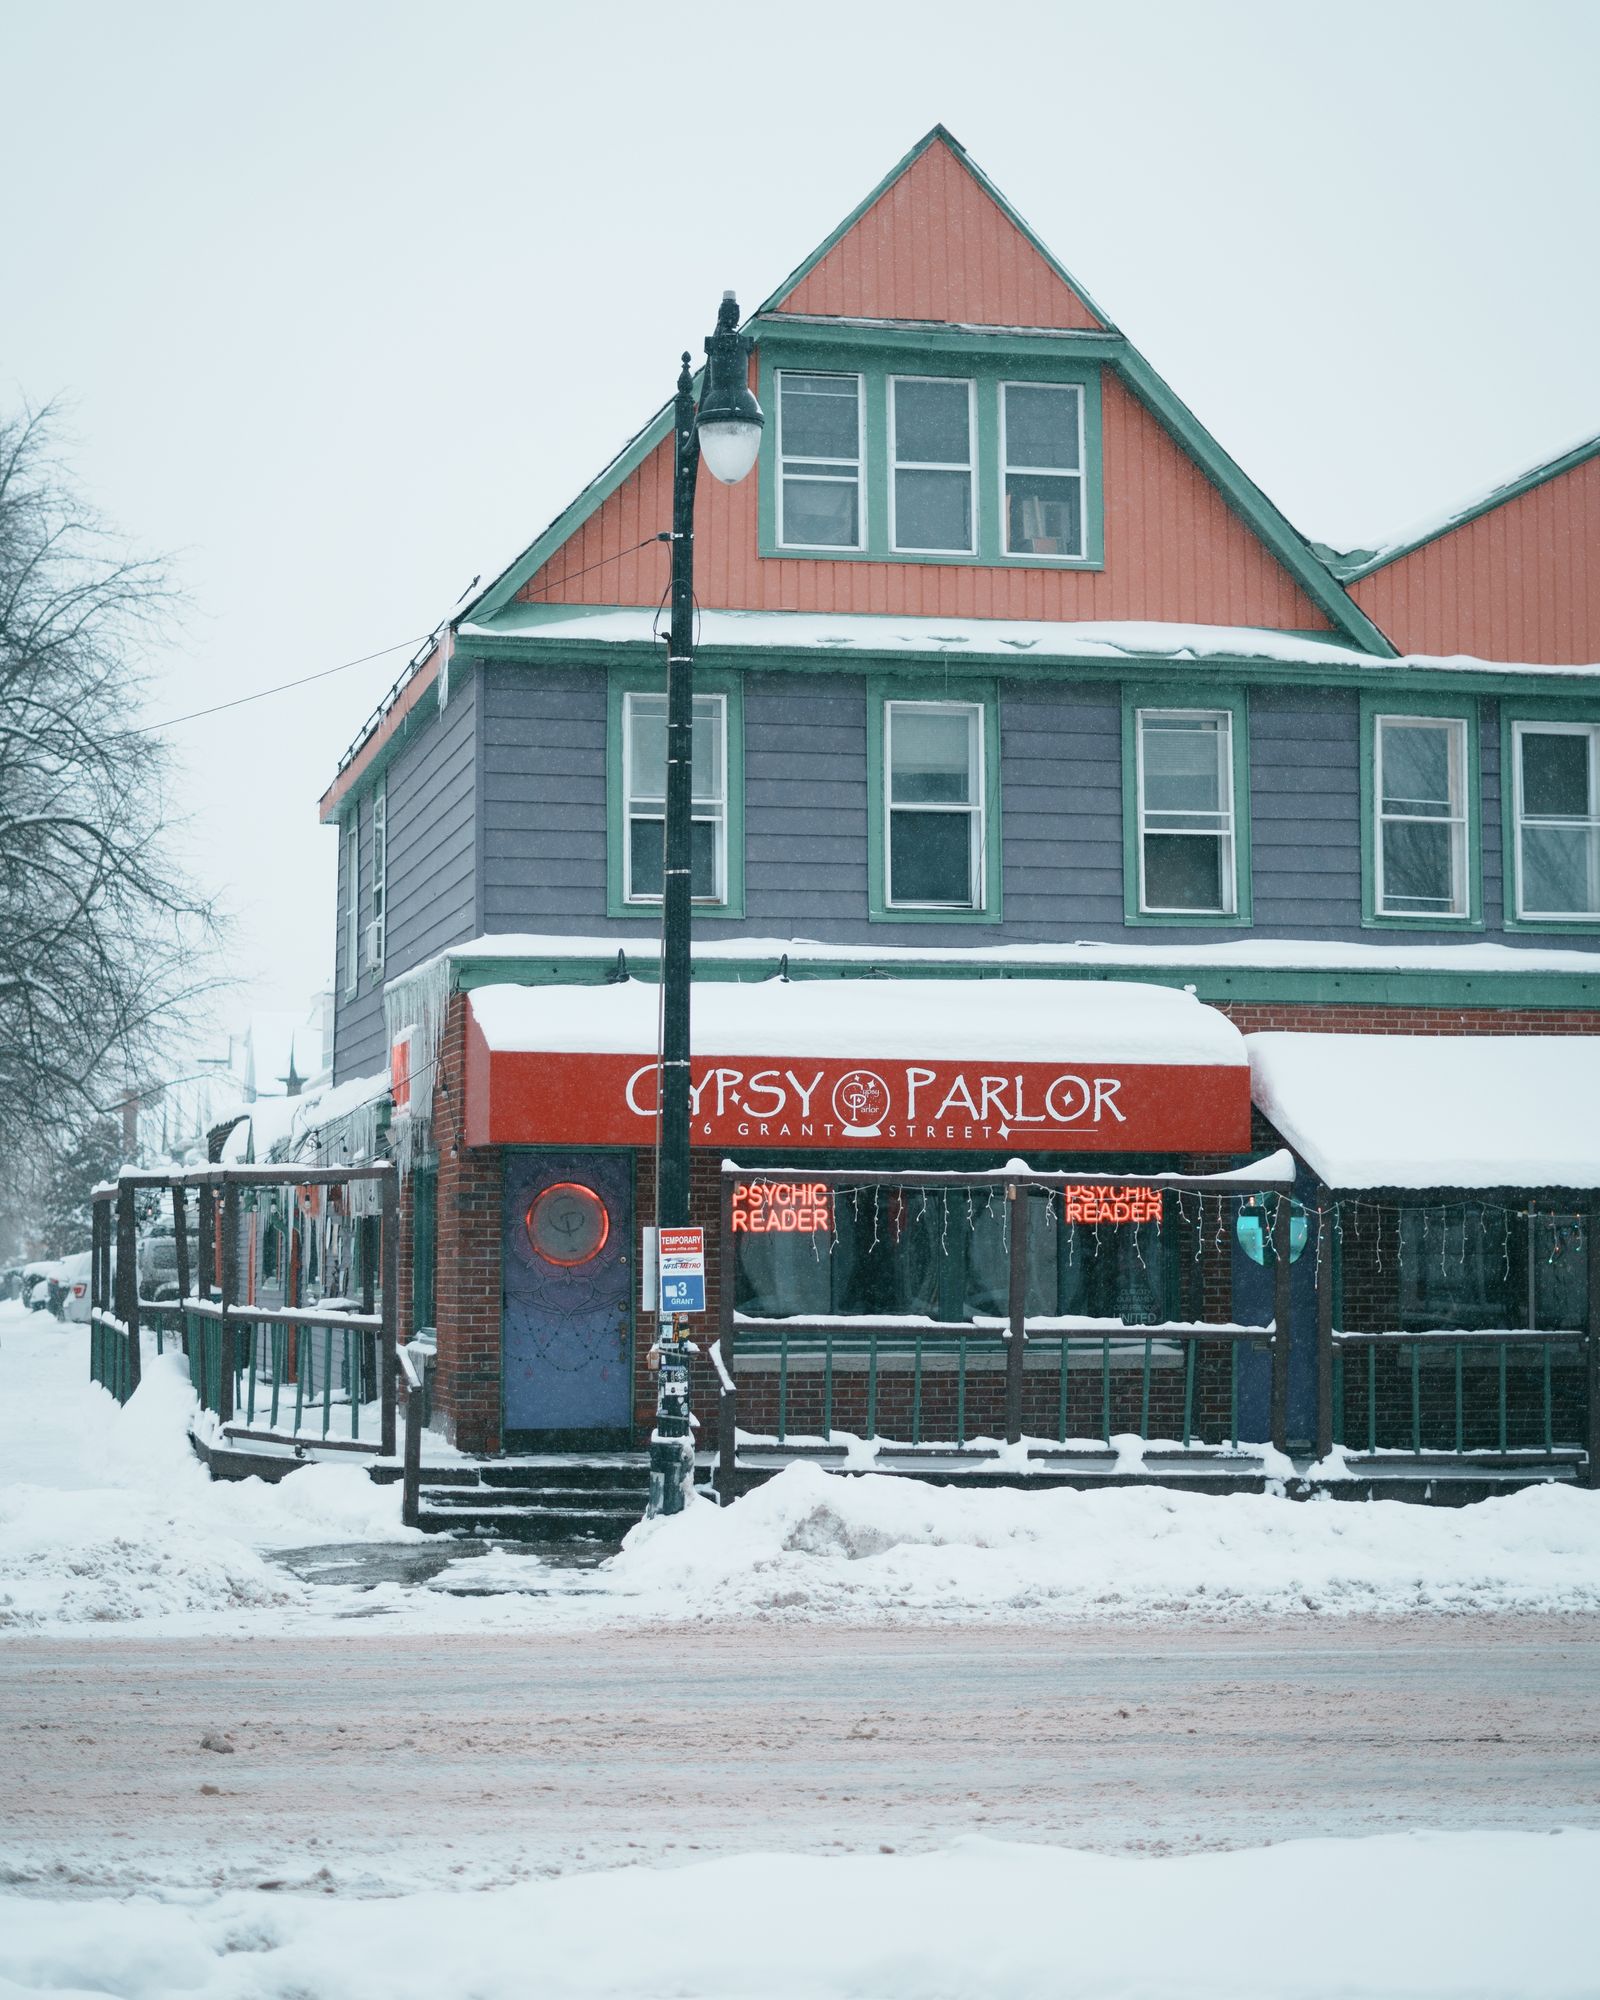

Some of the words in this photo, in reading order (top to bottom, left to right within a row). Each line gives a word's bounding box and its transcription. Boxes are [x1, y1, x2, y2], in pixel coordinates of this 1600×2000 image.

[625, 1063, 824, 1118] GYPSY
[905, 1067, 1126, 1122] PARLOR
[843, 1082, 880, 1109] Gypsy
[849, 1093, 880, 1122] Parlor
[737, 1122, 834, 1137] GRANT
[888, 1125, 993, 1139] STREET
[732, 1183, 828, 1207] PSYCHIC
[1065, 1184, 1163, 1203] PSYCHIC
[731, 1208, 829, 1233] READER
[1065, 1202, 1163, 1223] READER
[661, 1235, 702, 1245] TEMPORARY
[663, 1262, 702, 1270] NFTA-METRO
[678, 1281, 687, 1297] 3
